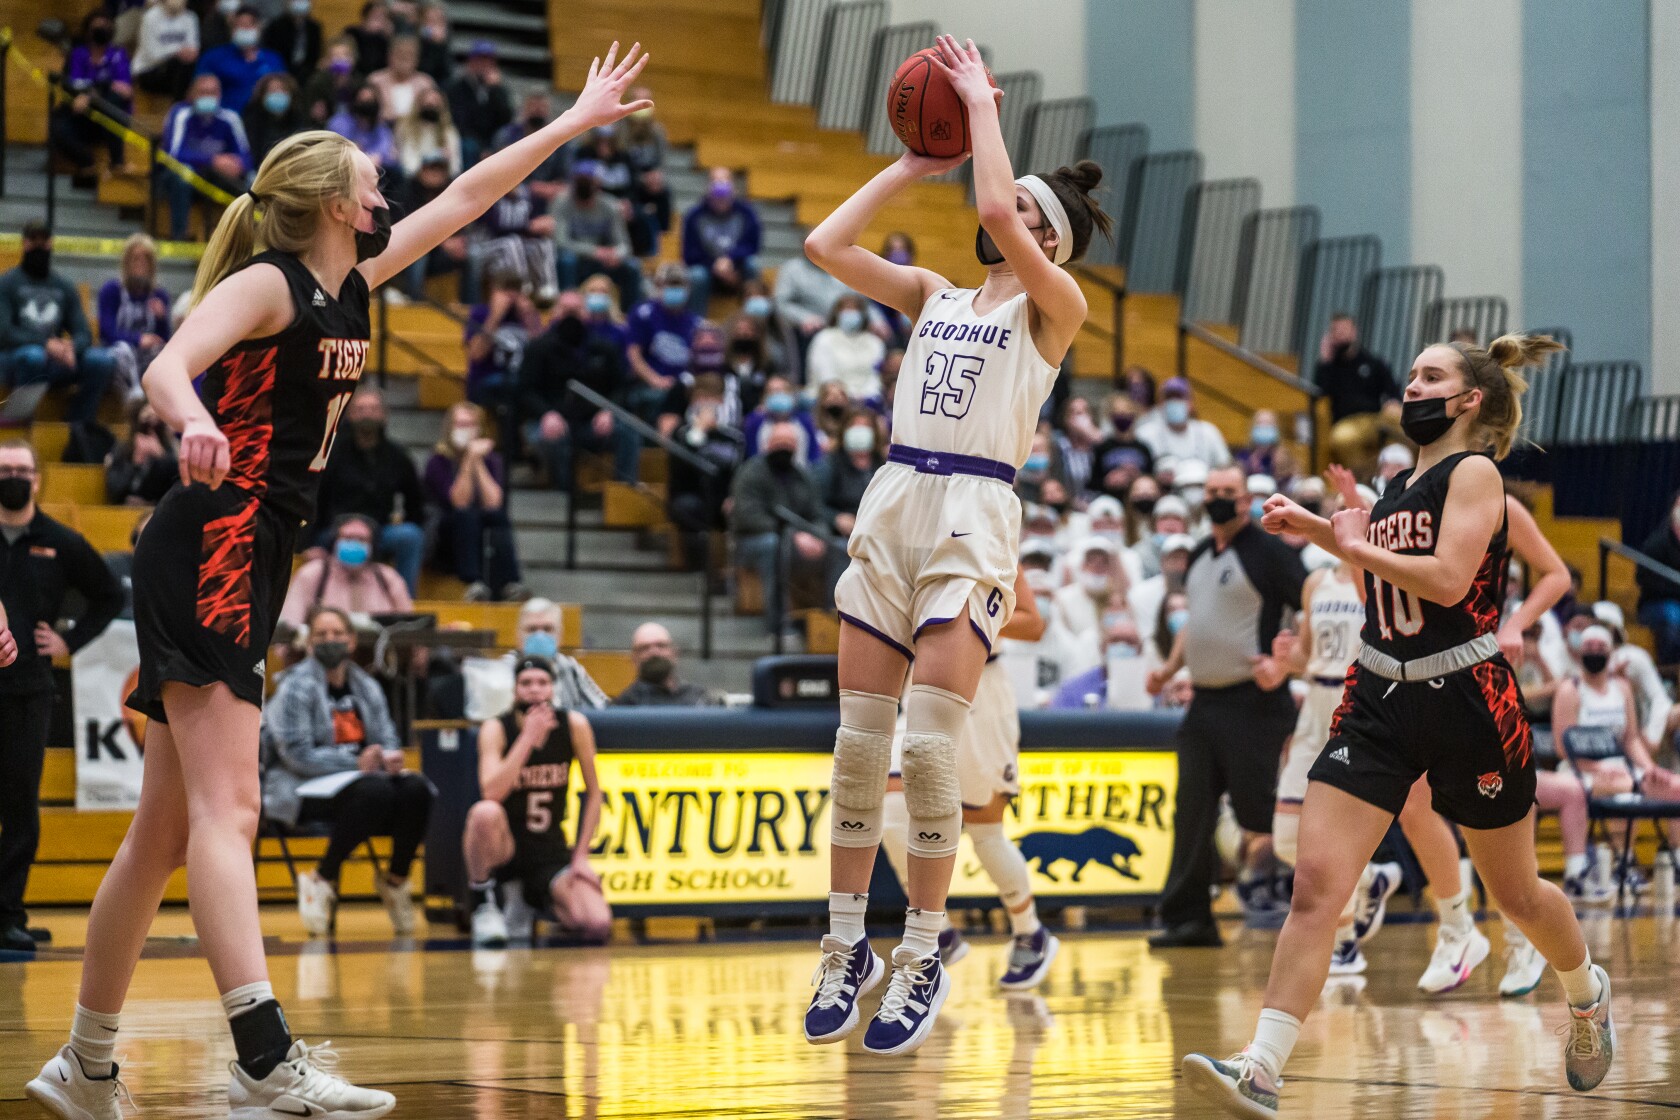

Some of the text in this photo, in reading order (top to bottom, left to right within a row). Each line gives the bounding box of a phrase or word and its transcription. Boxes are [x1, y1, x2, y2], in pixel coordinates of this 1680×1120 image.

[919, 320, 1012, 350] GOODHUE
[920, 350, 985, 420] 25
[1366, 509, 1433, 550] IGERS
[987, 586, 1003, 618] G
[1373, 573, 1425, 641] 10
[526, 791, 553, 832] 5
[576, 789, 832, 857] ENTURY
[667, 869, 792, 891] SCHOOL
